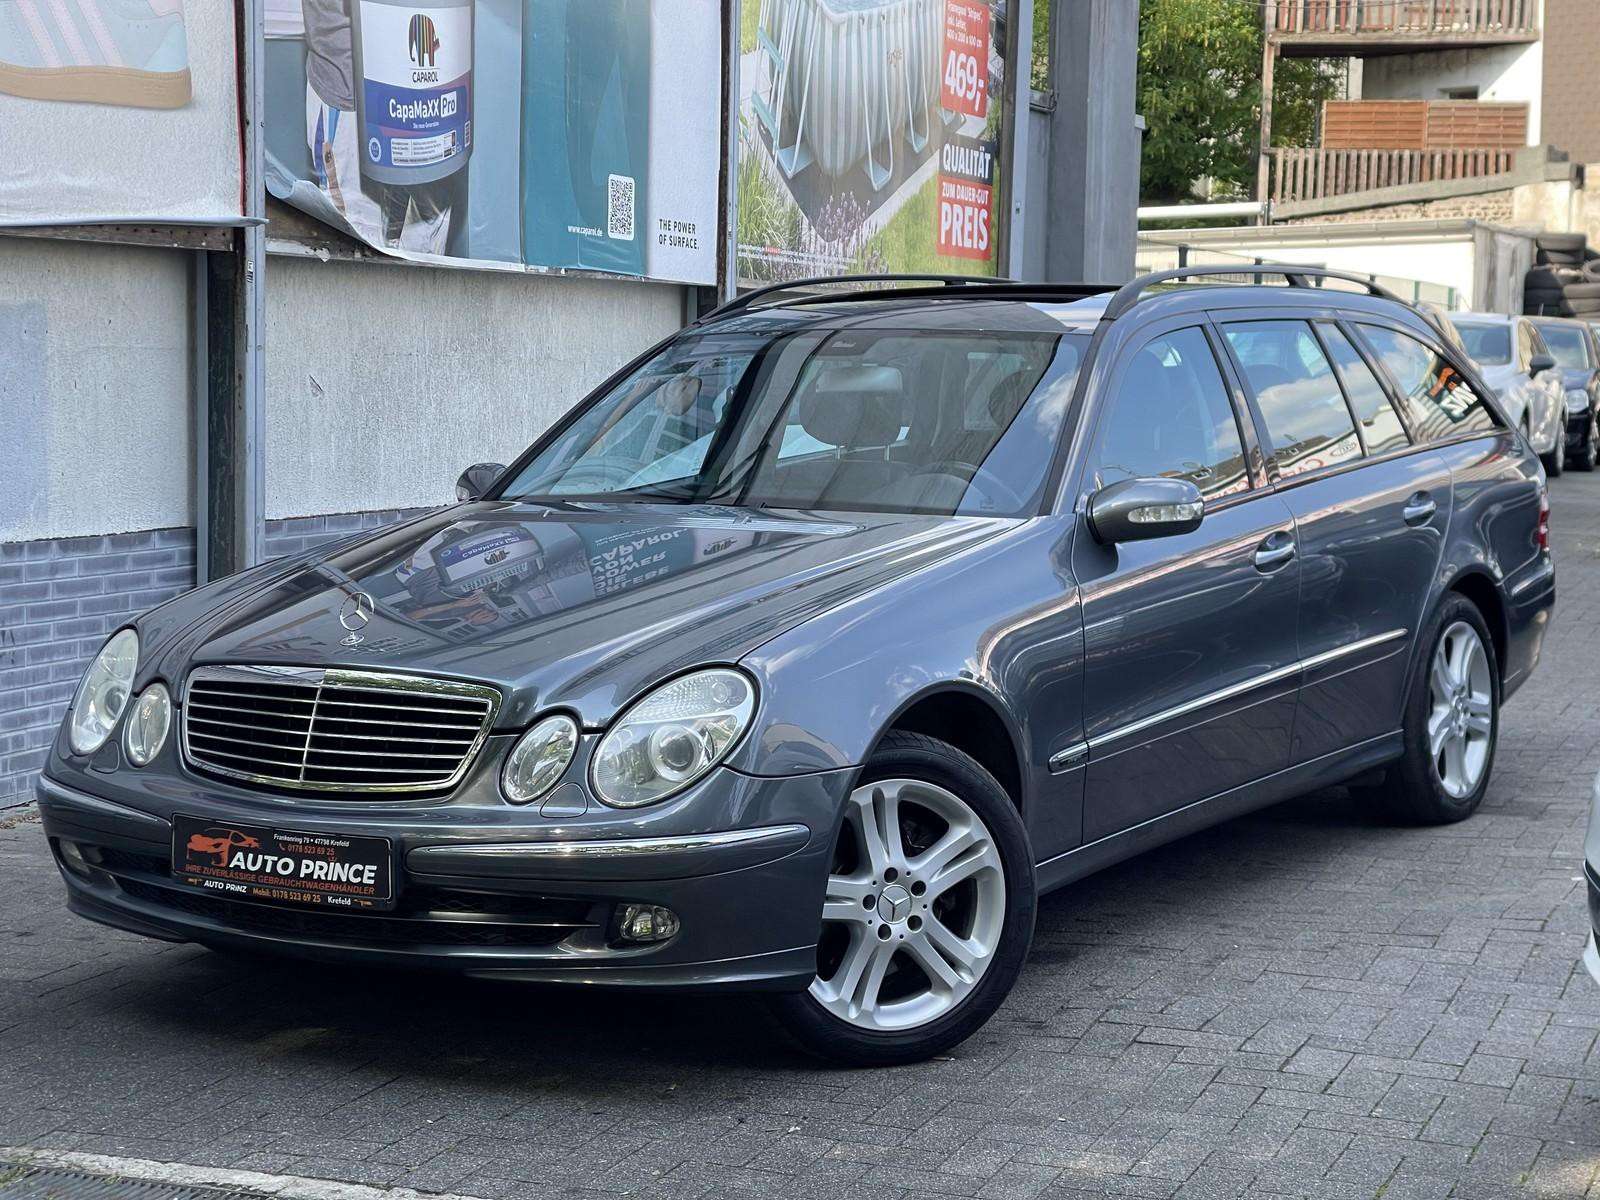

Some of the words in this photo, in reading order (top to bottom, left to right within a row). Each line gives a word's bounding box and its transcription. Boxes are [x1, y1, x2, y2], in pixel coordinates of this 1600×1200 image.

[412, 71, 439, 83] CAPAROL
[389, 98, 440, 122] CapaMaXX
[441, 95, 456, 115] Pro
[942, 143, 991, 179] QUALITÄT
[942, 181, 956, 198] ZUM
[567, 224, 603, 238] www.caparol.de
[659, 218, 671, 231] THE
[673, 221, 696, 235] POWER
[940, 201, 988, 251] PREIS
[658, 234, 667, 246] OF
[669, 235, 700, 250] SURFACE.
[287, 843, 303, 853] 0178
[304, 845, 316, 854] 523
[316, 846, 325, 855] 69
[326, 847, 335, 856] 25
[330, 839, 350, 847] Krefeld
[185, 863, 201, 873] IHRE
[229, 851, 295, 875] AUTO
[300, 859, 377, 885] PRINCE
[203, 880, 224, 890] AUTO
[253, 888, 271, 897] Mobil:
[272, 889, 288, 899] 0178
[289, 892, 301, 901] 523
[302, 893, 311, 902] 69
[312, 894, 321, 903] 25
[327, 896, 351, 906] Krefeld
